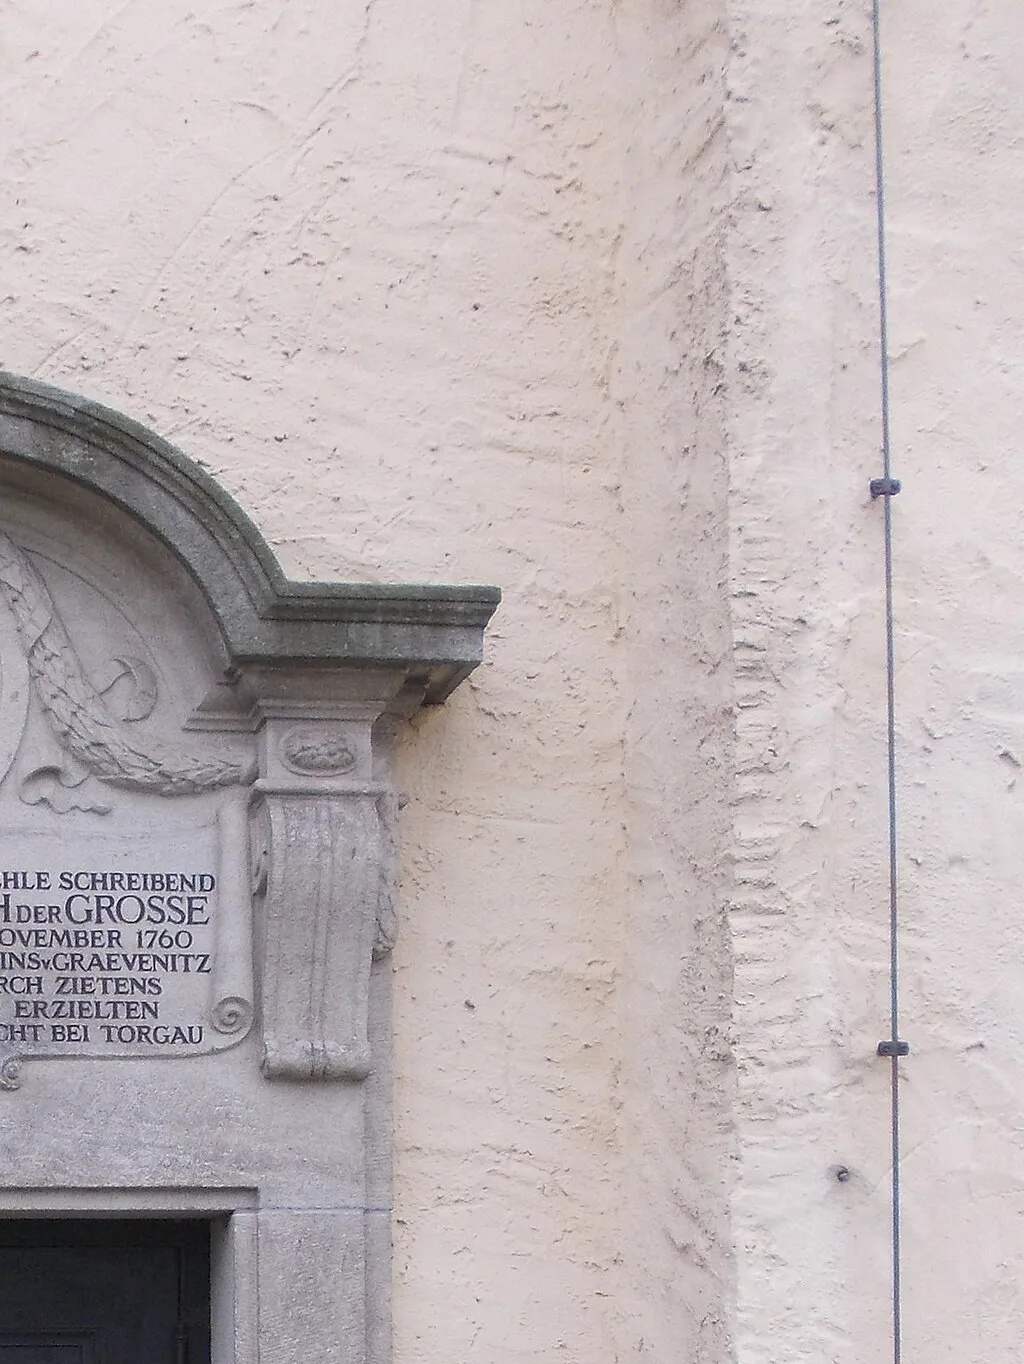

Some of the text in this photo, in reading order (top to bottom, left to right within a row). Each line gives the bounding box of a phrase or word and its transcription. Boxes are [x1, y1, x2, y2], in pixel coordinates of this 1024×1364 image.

[59, 872, 215, 892] SCHREIBEND
[16, 905, 62, 924] DER
[65, 895, 209, 925] GROSSE
[136, 930, 193, 949] 1760
[53, 953, 211, 973] GRAEVENITZ
[55, 977, 162, 996] ZIETENS
[14, 1001, 159, 1019] ERZIELTEN
[51, 1025, 90, 1042] BEI
[96, 1025, 203, 1044] TORGAU
